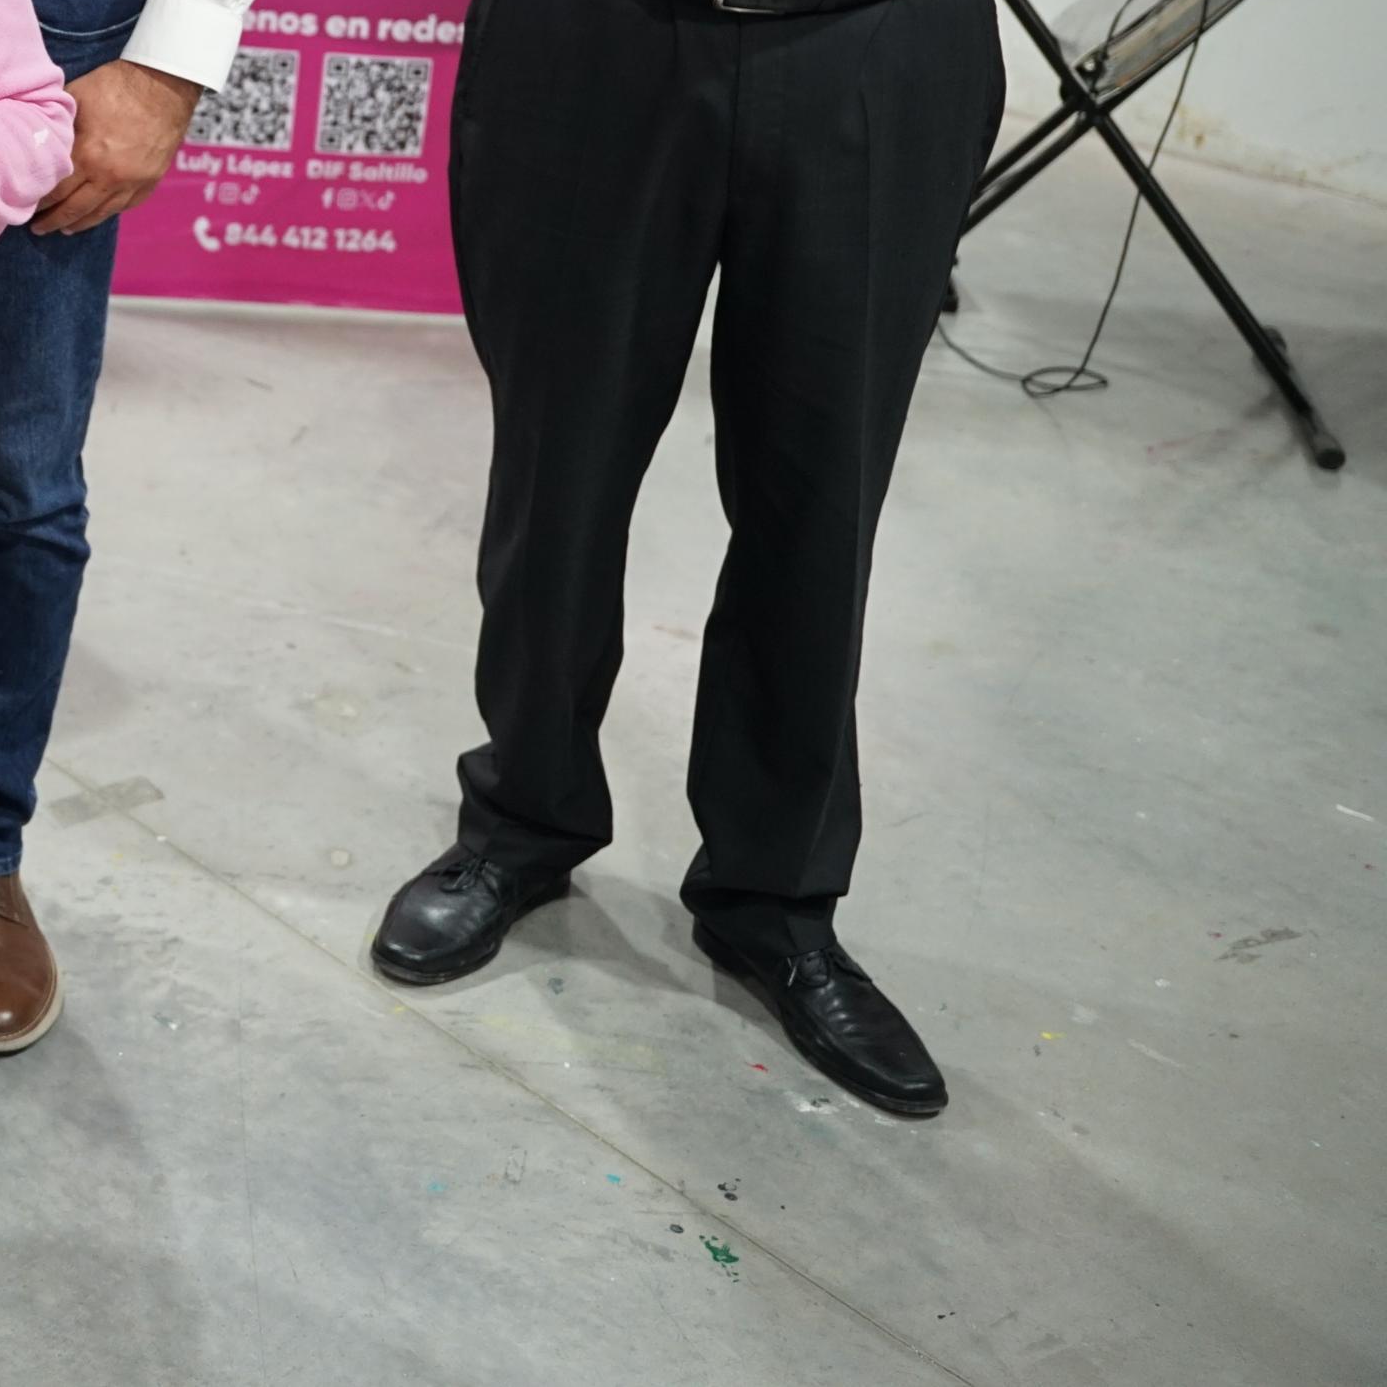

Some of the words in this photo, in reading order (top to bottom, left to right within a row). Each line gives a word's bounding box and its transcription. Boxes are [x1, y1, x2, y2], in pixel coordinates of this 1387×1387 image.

[324, 15, 369, 39] en
[176, 149, 223, 176] Luly
[227, 150, 294, 180] López
[306, 158, 341, 180] DIF
[348, 160, 429, 184] Saltillo
[223, 222, 277, 246] 844
[282, 224, 328, 250] 412
[334, 226, 397, 253] 1264
